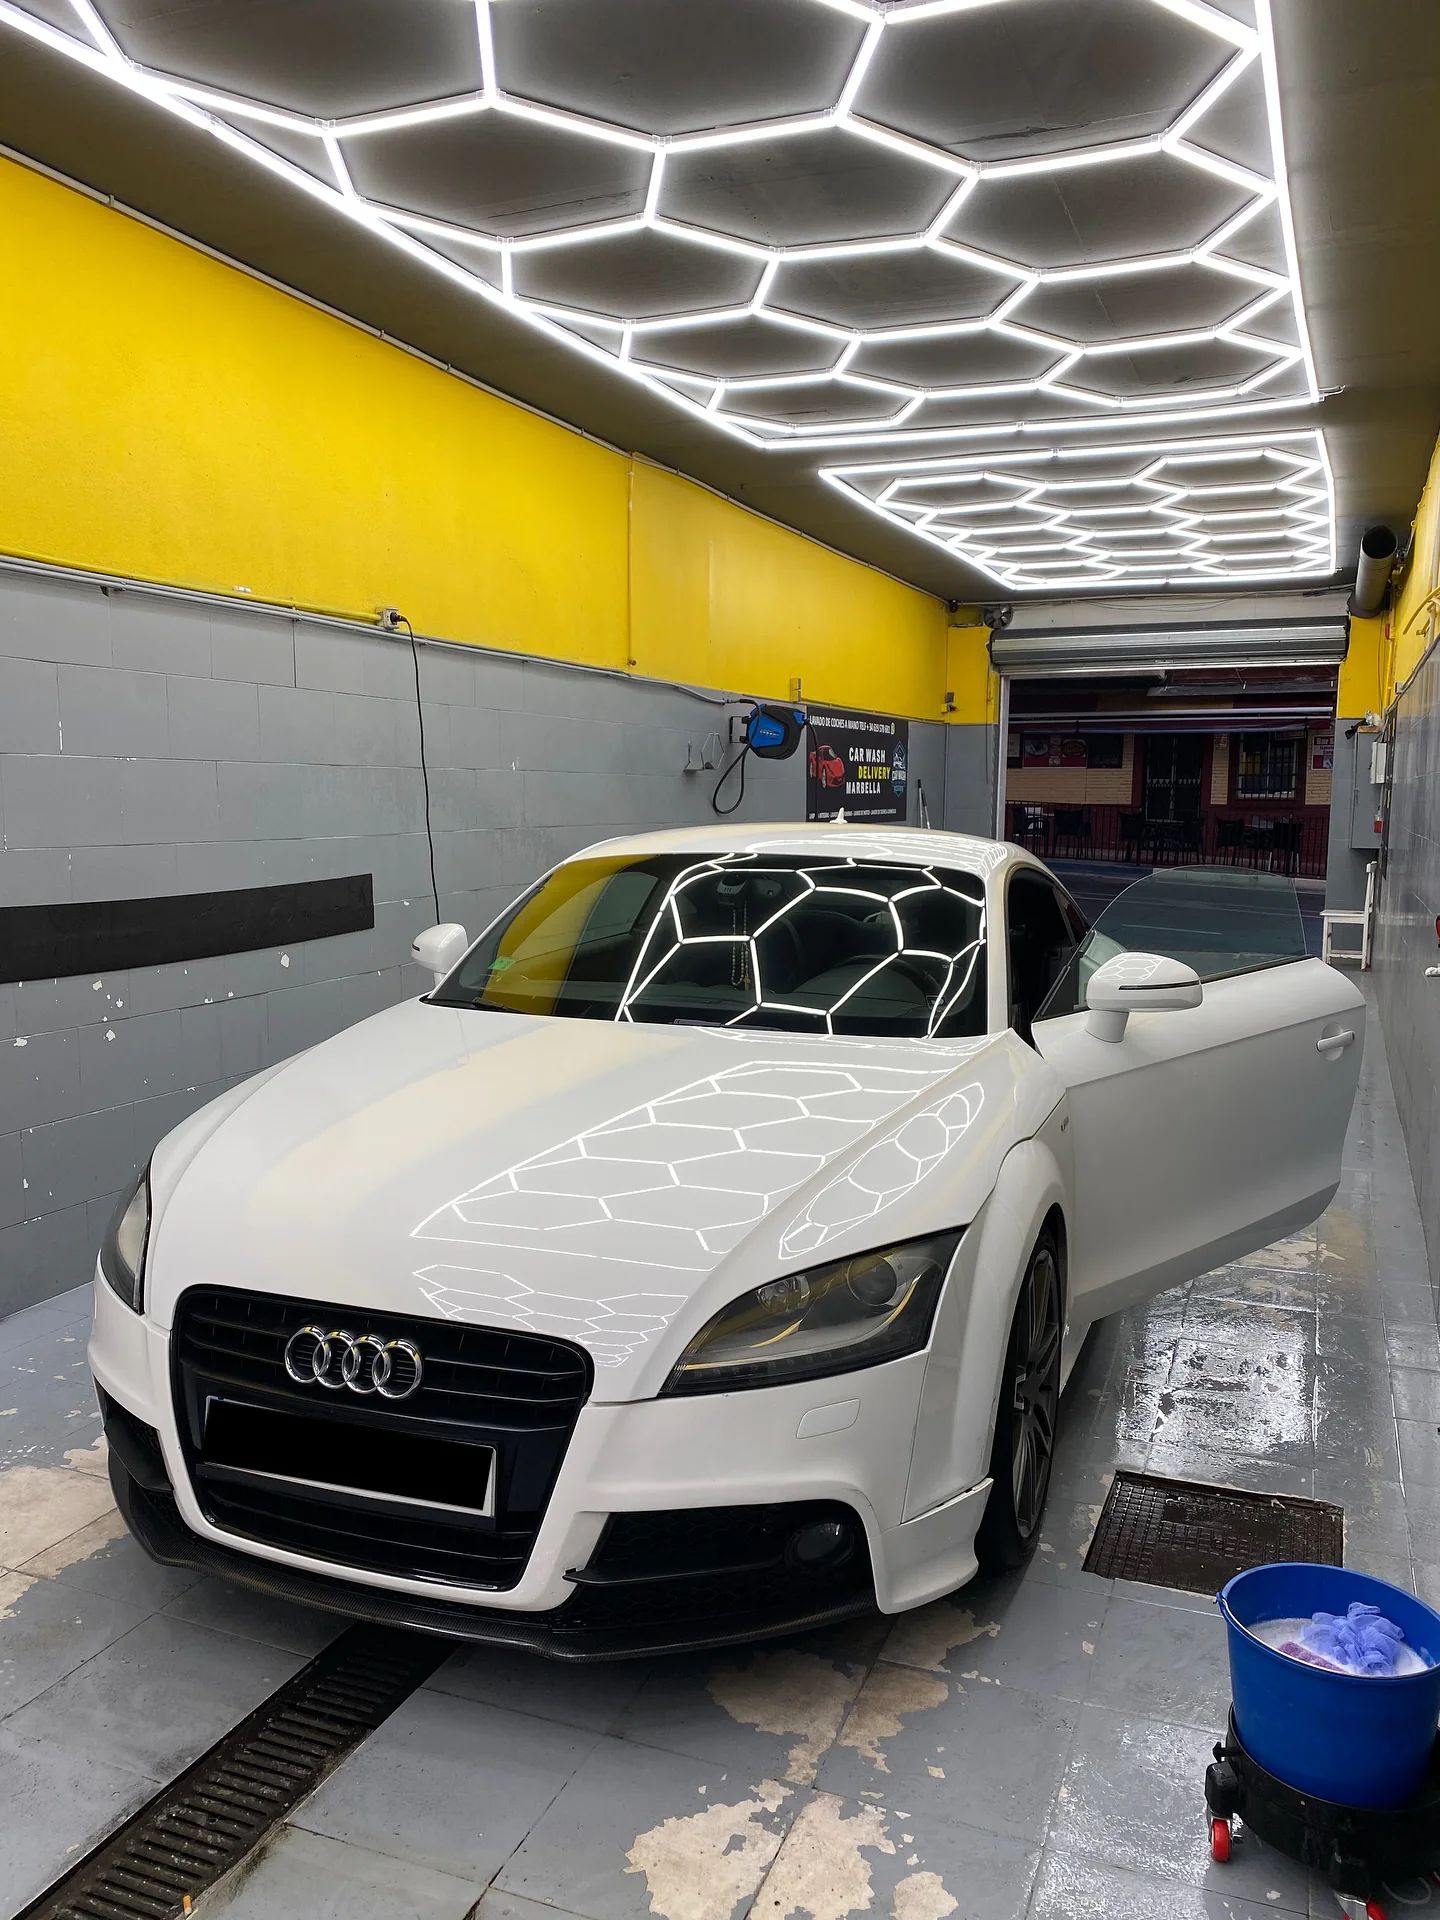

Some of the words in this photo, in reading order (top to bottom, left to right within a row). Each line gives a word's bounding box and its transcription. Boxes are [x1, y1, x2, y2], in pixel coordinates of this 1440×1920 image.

[809, 715, 825, 727] LAVADO
[825, 717, 831, 727] DE
[849, 747, 864, 762] CAR
[865, 748, 886, 763] WASH
[858, 765, 891, 780] DELIVERY
[846, 781, 881, 795] MARBELLA
